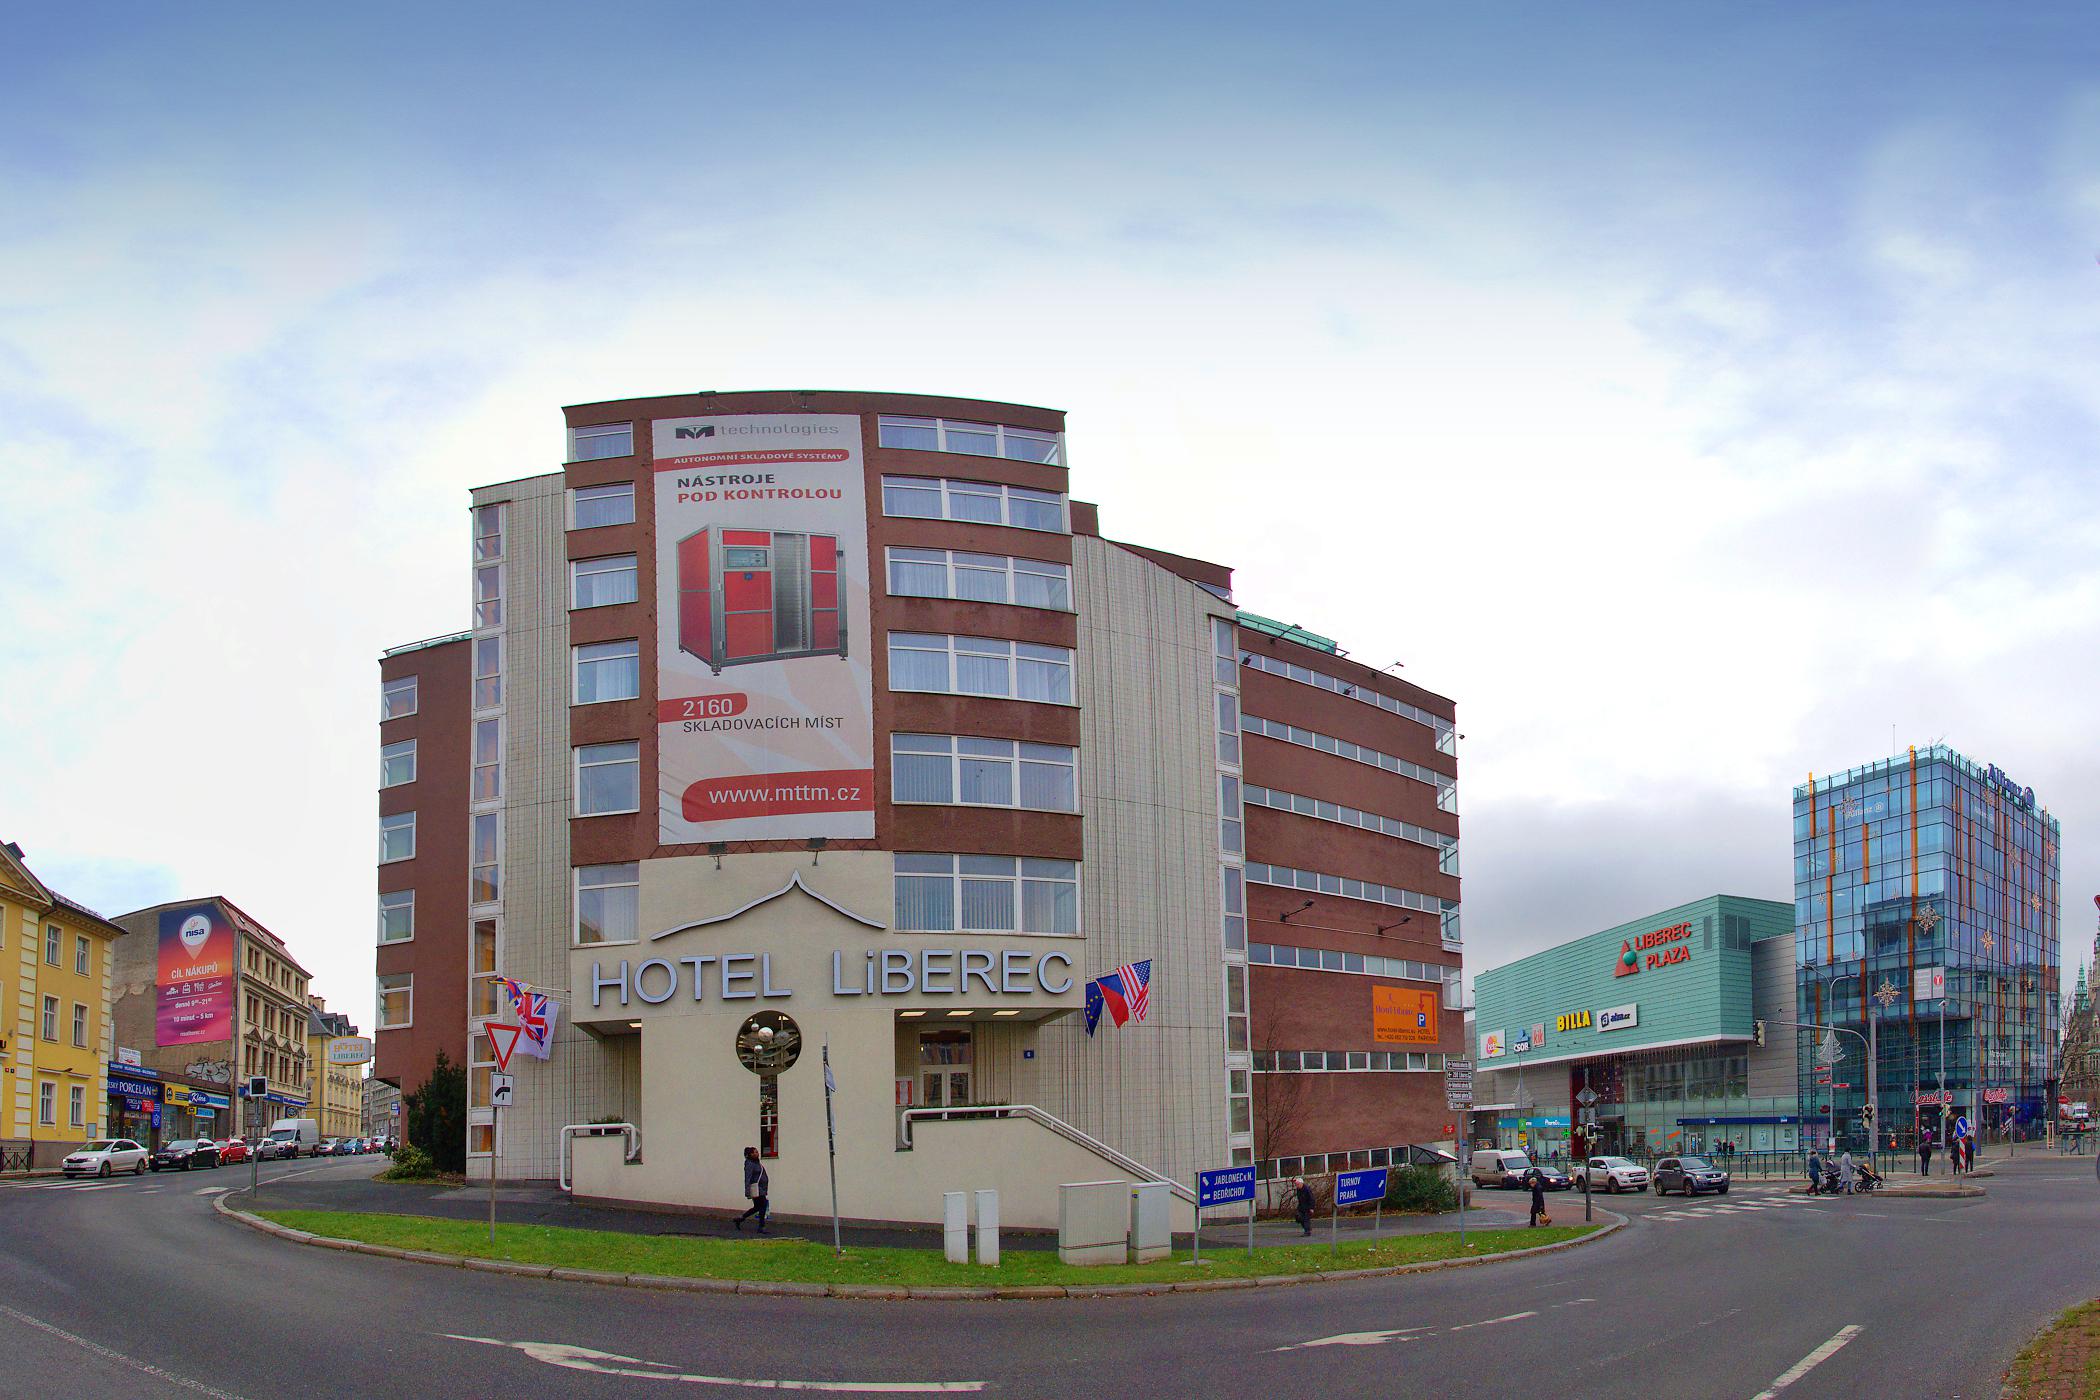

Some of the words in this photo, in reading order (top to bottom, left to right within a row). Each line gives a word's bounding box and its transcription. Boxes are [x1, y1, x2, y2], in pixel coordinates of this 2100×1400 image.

[720, 423, 840, 436] technologies
[677, 473, 776, 489] NÁSTROJE
[678, 491, 718, 504] POD
[724, 488, 843, 501] KONTROLOU
[682, 698, 734, 718] 2160
[683, 716, 800, 733] SKLADOVACÍCH
[805, 715, 844, 729] MÍST
[708, 785, 861, 804] www.mttm.cz
[185, 928, 205, 938] nisa
[1634, 921, 1692, 951] LIBEREC
[1646, 945, 1691, 971] PLAZA
[171, 967, 184, 979] CÍL
[185, 961, 218, 977] NÁKUPŮ
[593, 952, 793, 1007] HOTEL
[1556, 1009, 1591, 1032] BILLA
[1213, 1172, 1244, 1186] JABLONEC
[1340, 1176, 1361, 1188] TURNOV
[1213, 1186, 1246, 1201] BEDŘICHOV
[1339, 1189, 1357, 1201] PRAHA
